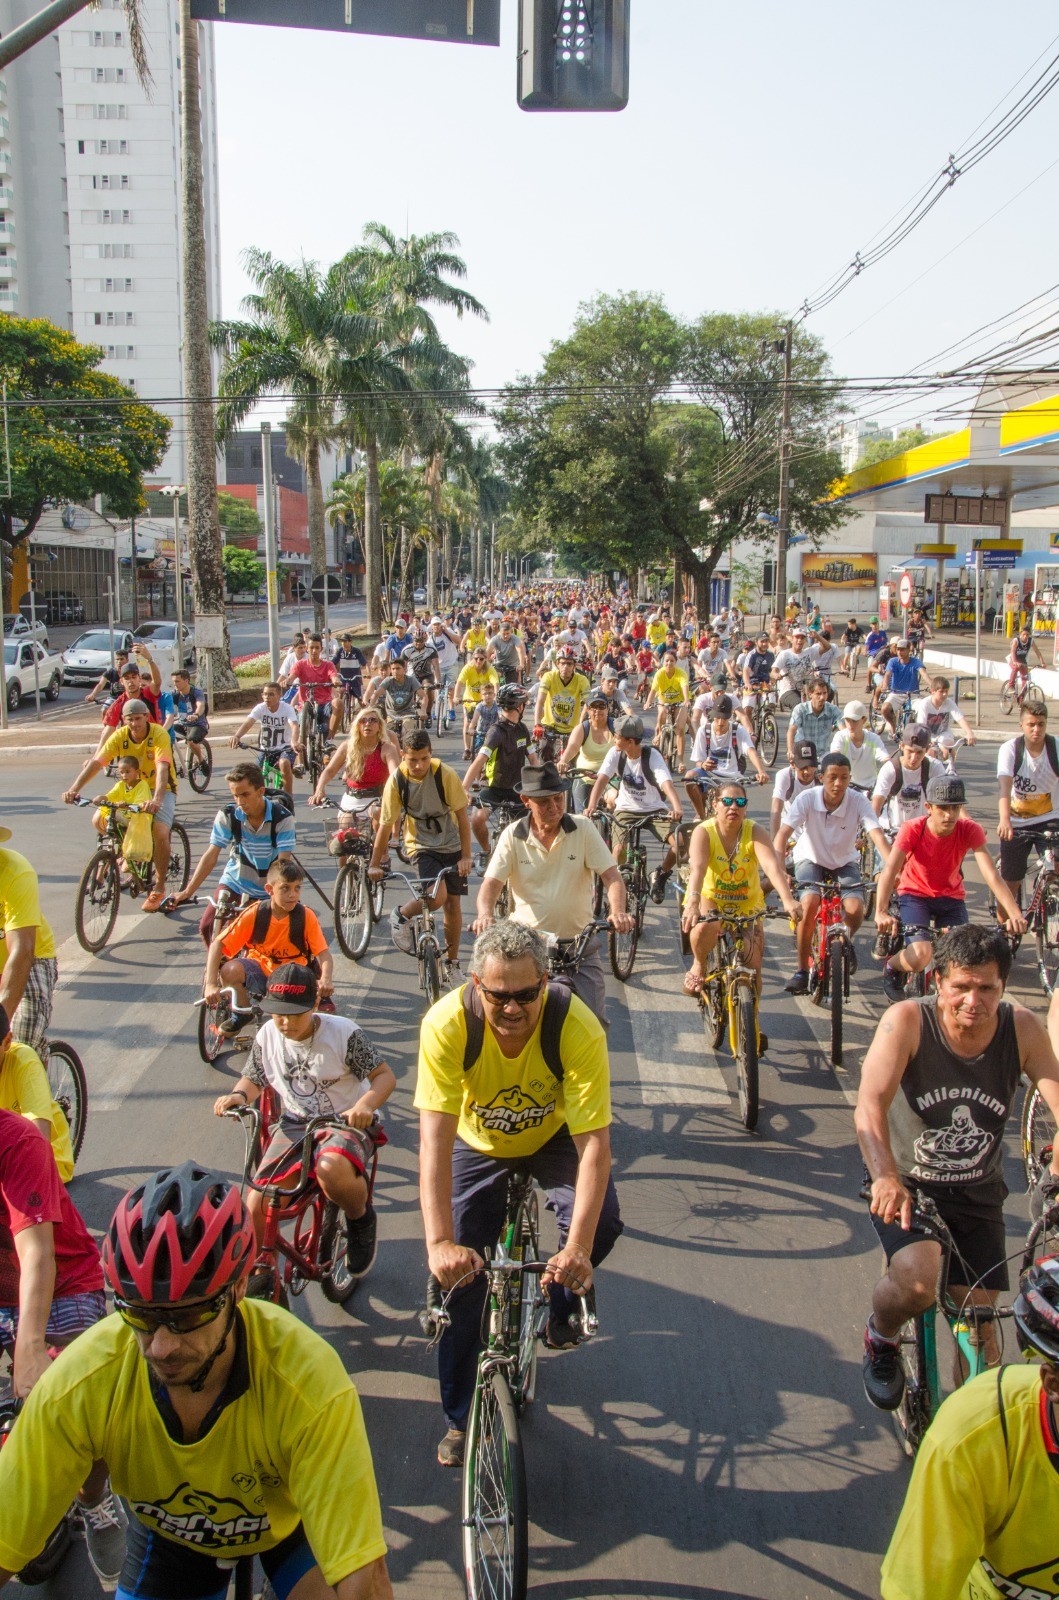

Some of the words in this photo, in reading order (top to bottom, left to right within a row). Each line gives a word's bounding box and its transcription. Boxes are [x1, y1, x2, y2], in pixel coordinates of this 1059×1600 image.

[916, 1086, 1006, 1116] Milenium
[483, 1119, 512, 1132] FM
[910, 1165, 983, 1182] Academia
[160, 1521, 206, 1544] FM
